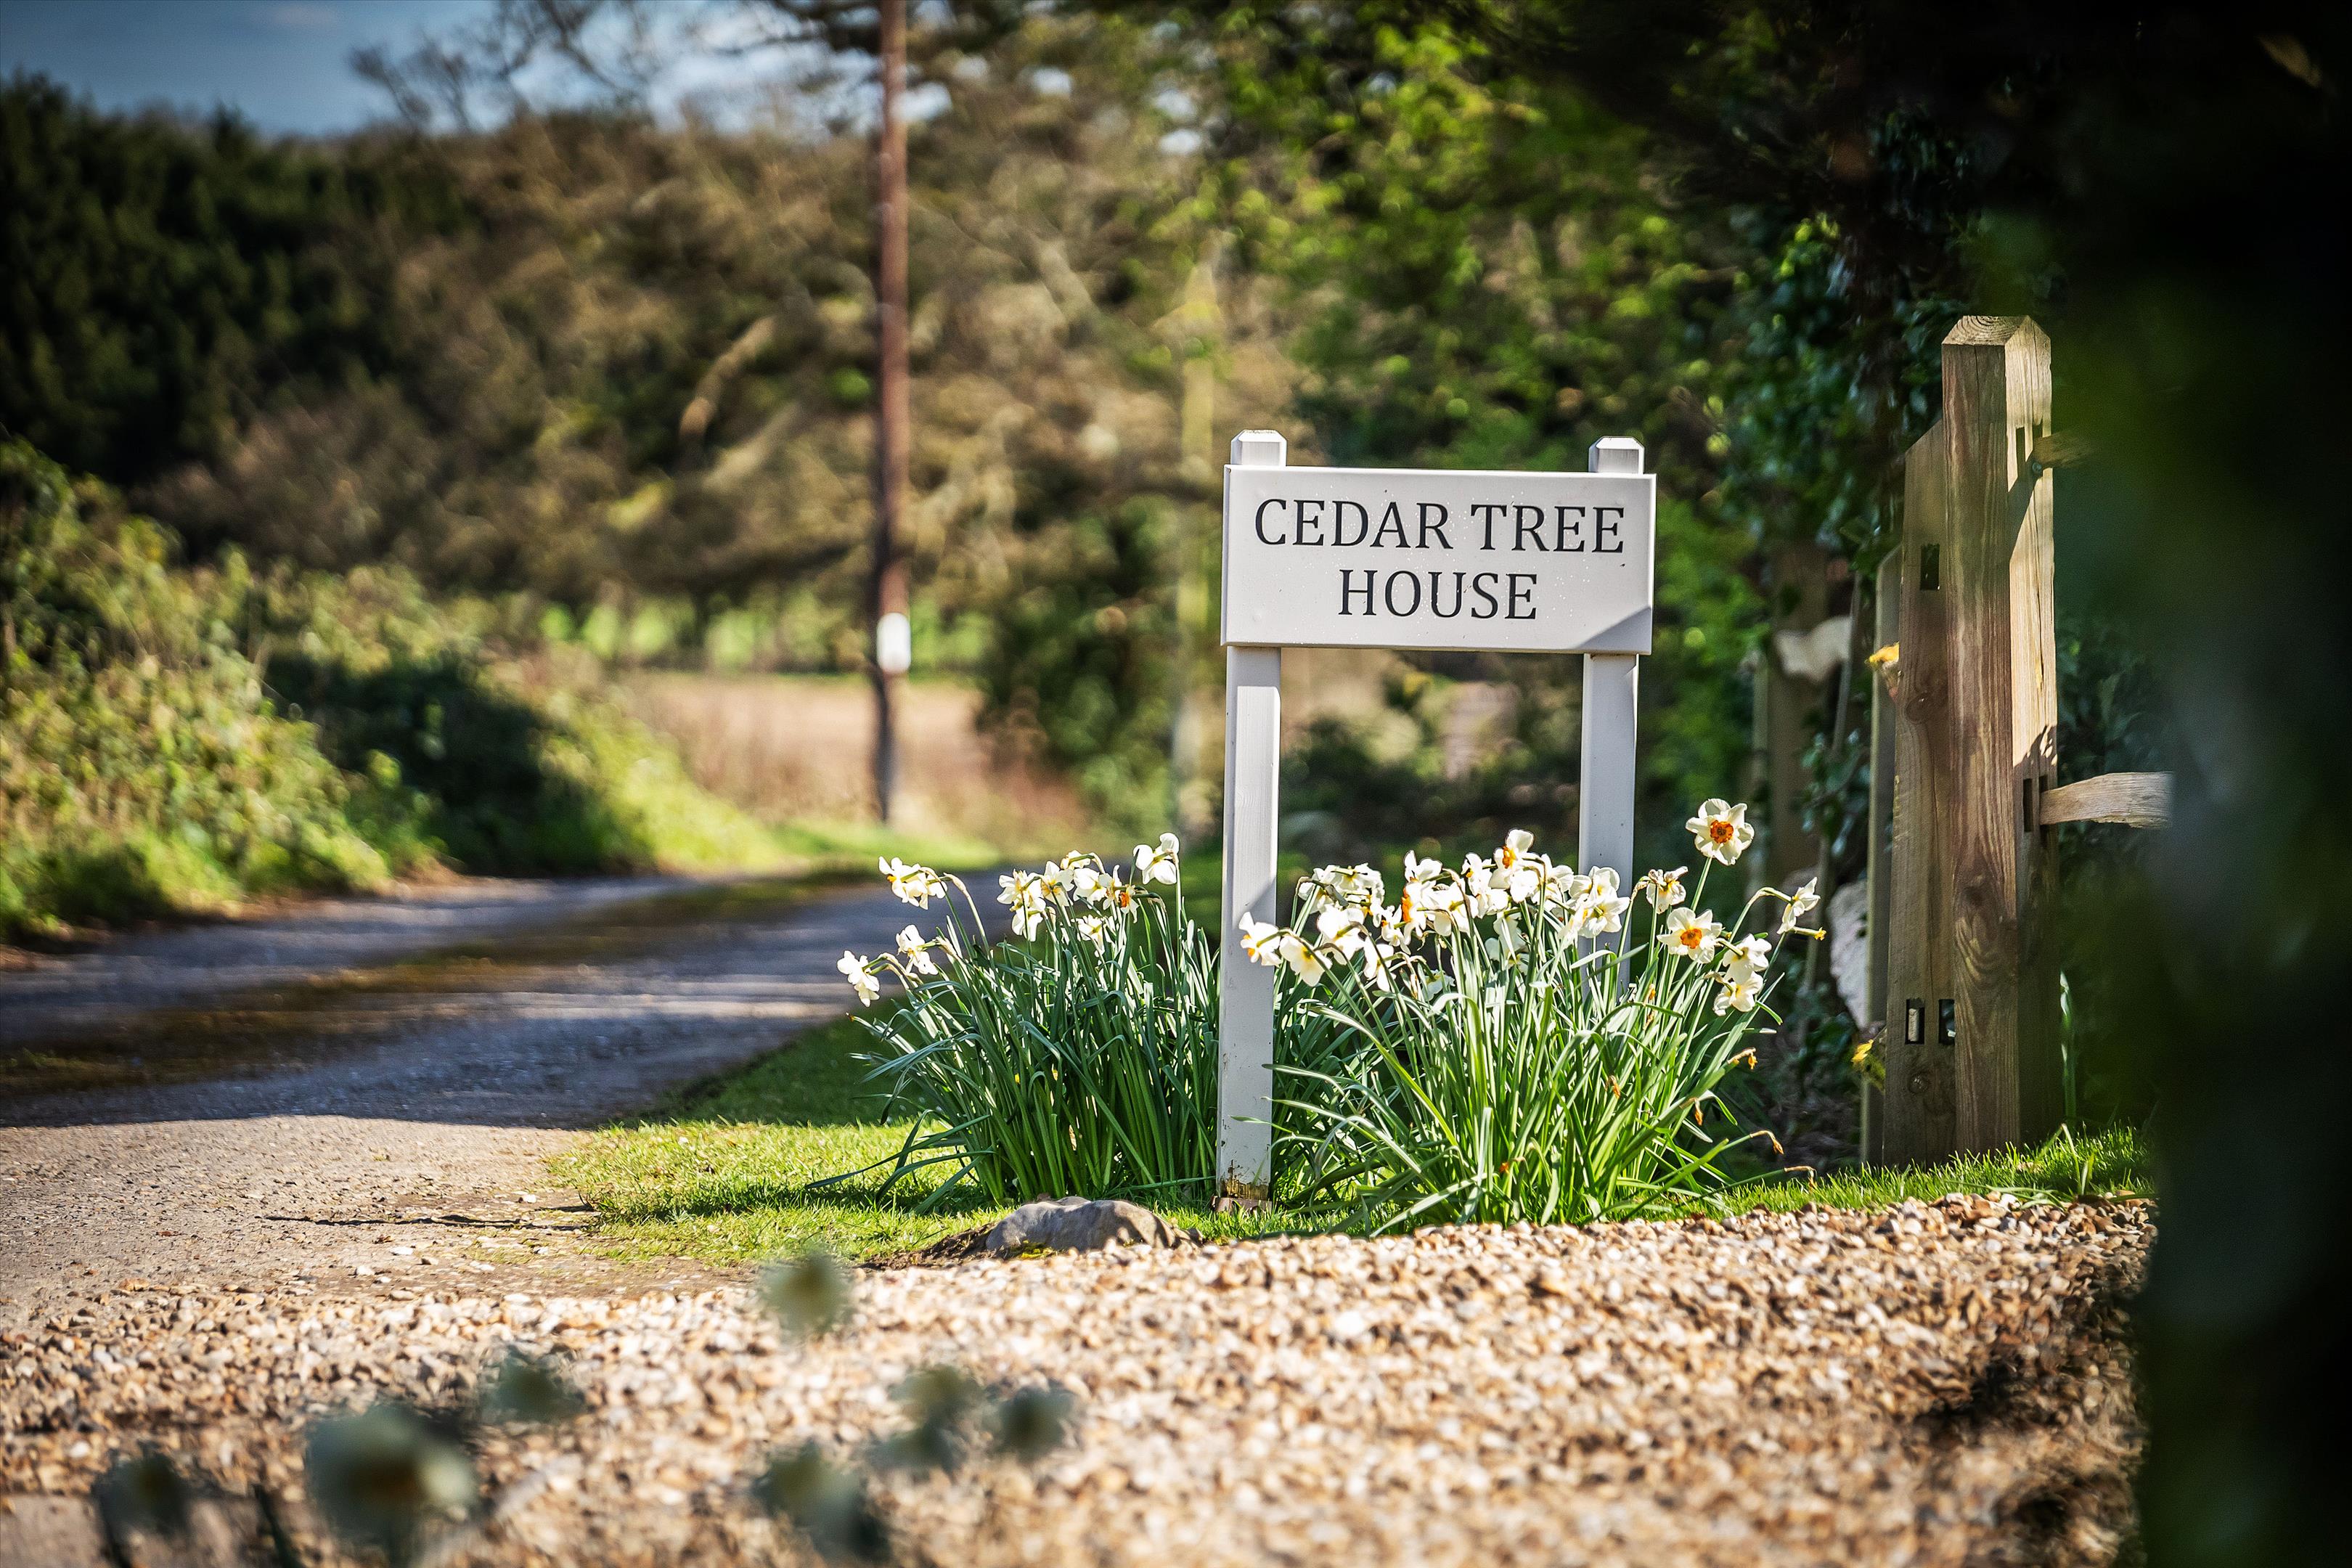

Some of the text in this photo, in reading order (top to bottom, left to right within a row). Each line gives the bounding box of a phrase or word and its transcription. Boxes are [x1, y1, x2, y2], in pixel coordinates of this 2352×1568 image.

[1255, 499, 1625, 554] CEDAR TREE
[1338, 569, 1538, 620] HOUSE
